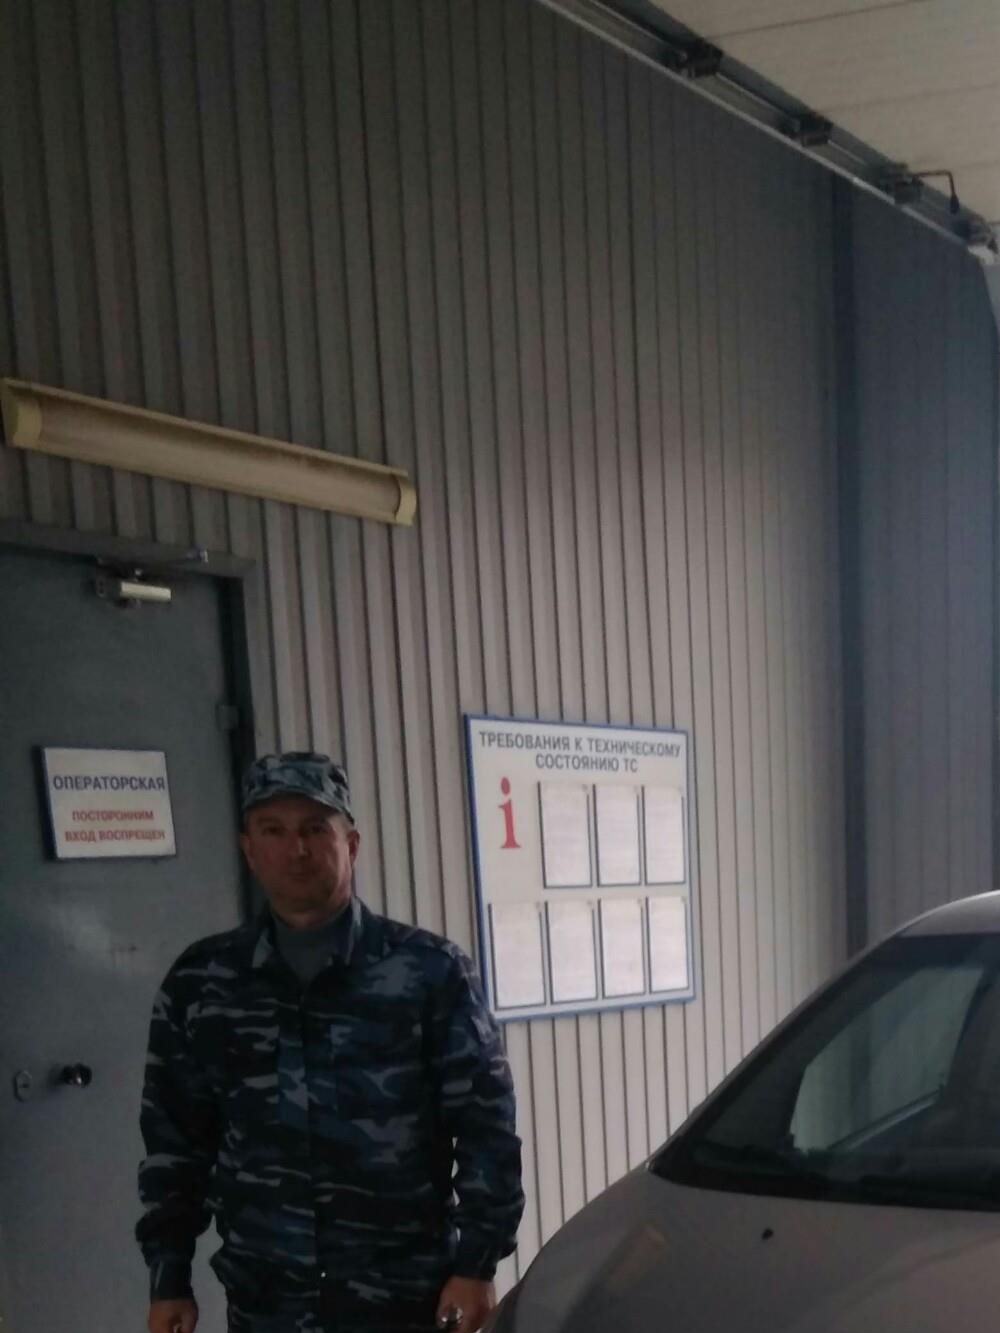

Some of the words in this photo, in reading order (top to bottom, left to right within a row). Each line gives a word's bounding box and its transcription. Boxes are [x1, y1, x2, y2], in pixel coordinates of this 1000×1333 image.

[479, 731, 570, 751] ТРЕБОВАНИЯ
[575, 738, 583, 751] К
[587, 738, 681, 758] ТЕХНИЧЕСКОМУ
[535, 754, 619, 772] СОСТОЯНИЮ
[623, 759, 638, 773] ТС
[53, 775, 166, 790] ОПЕРАТОРСКАЯ
[72, 810, 154, 821] ПОСТОРОННИМ
[65, 831, 97, 842] ВХОД
[99, 830, 166, 841] ВОСПРЕЩЕН
